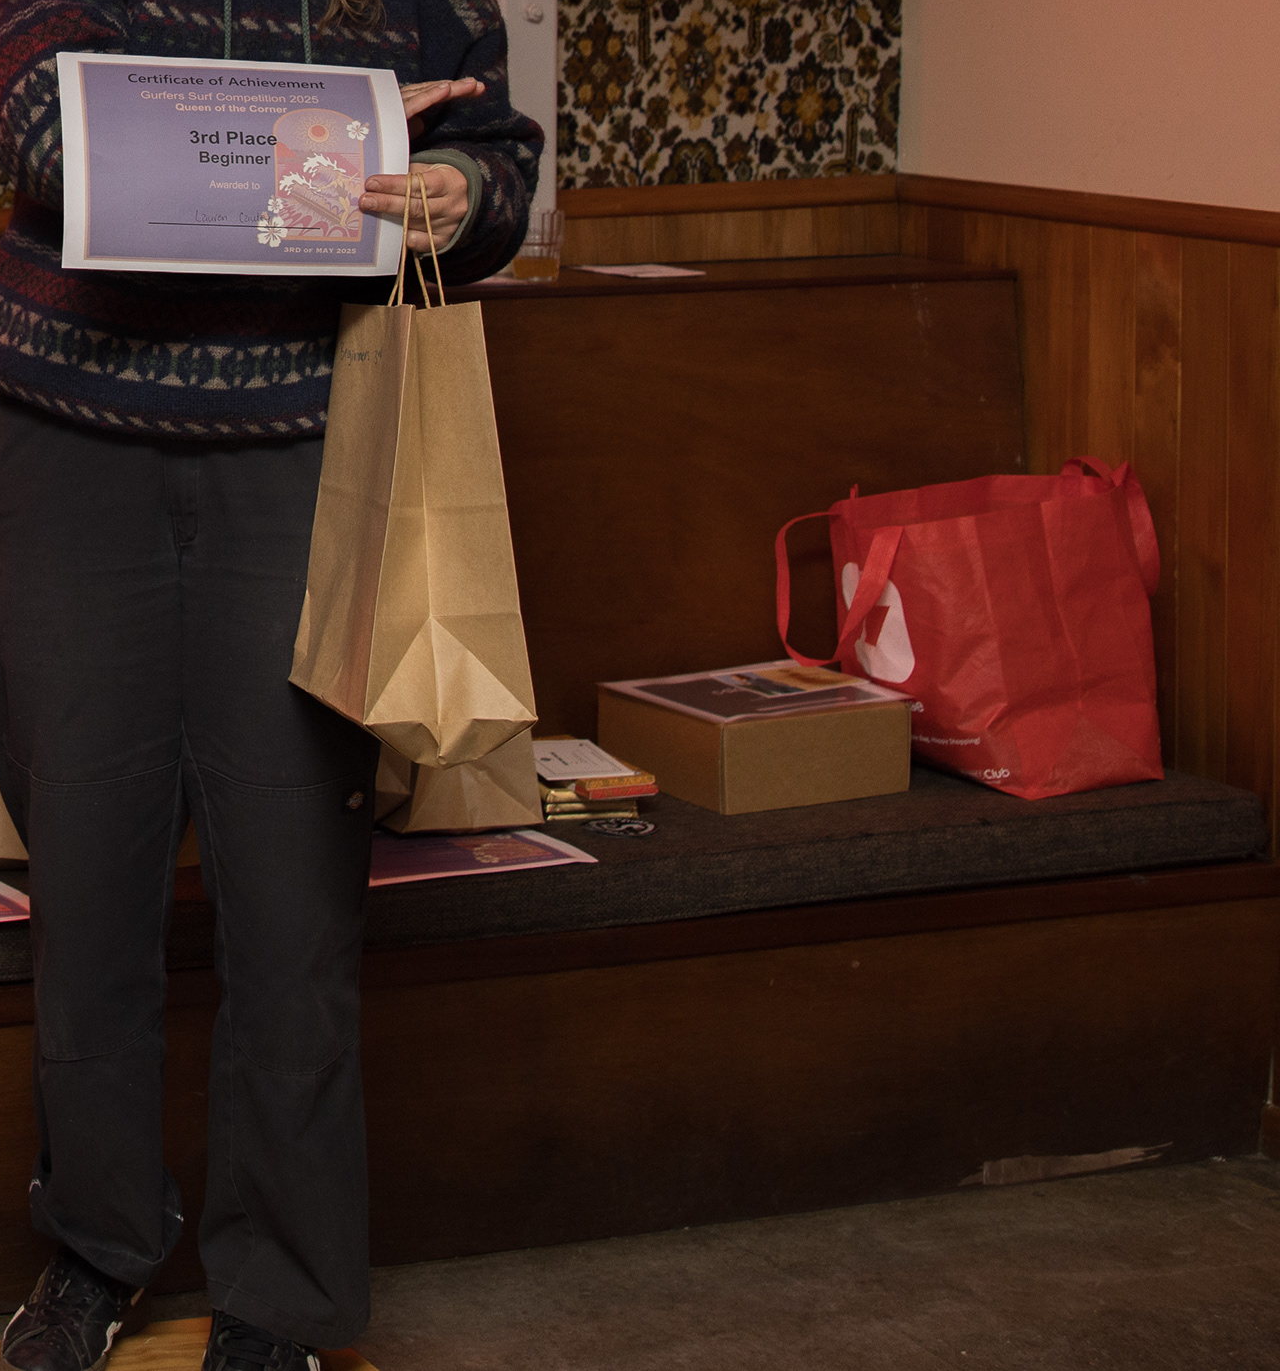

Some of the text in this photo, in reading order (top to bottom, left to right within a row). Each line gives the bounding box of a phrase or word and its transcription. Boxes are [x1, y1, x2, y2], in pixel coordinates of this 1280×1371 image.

[127, 73, 326, 90] Certificate of Achievement
[140, 90, 319, 104] Gurfers Surf Competition 2025
[175, 102, 288, 114] Queen of the Corner
[189, 130, 278, 146] 3rd Place
[198, 150, 271, 167] Beginner
[208, 180, 261, 191] Awarded to
[983, 767, 1010, 779] Club
